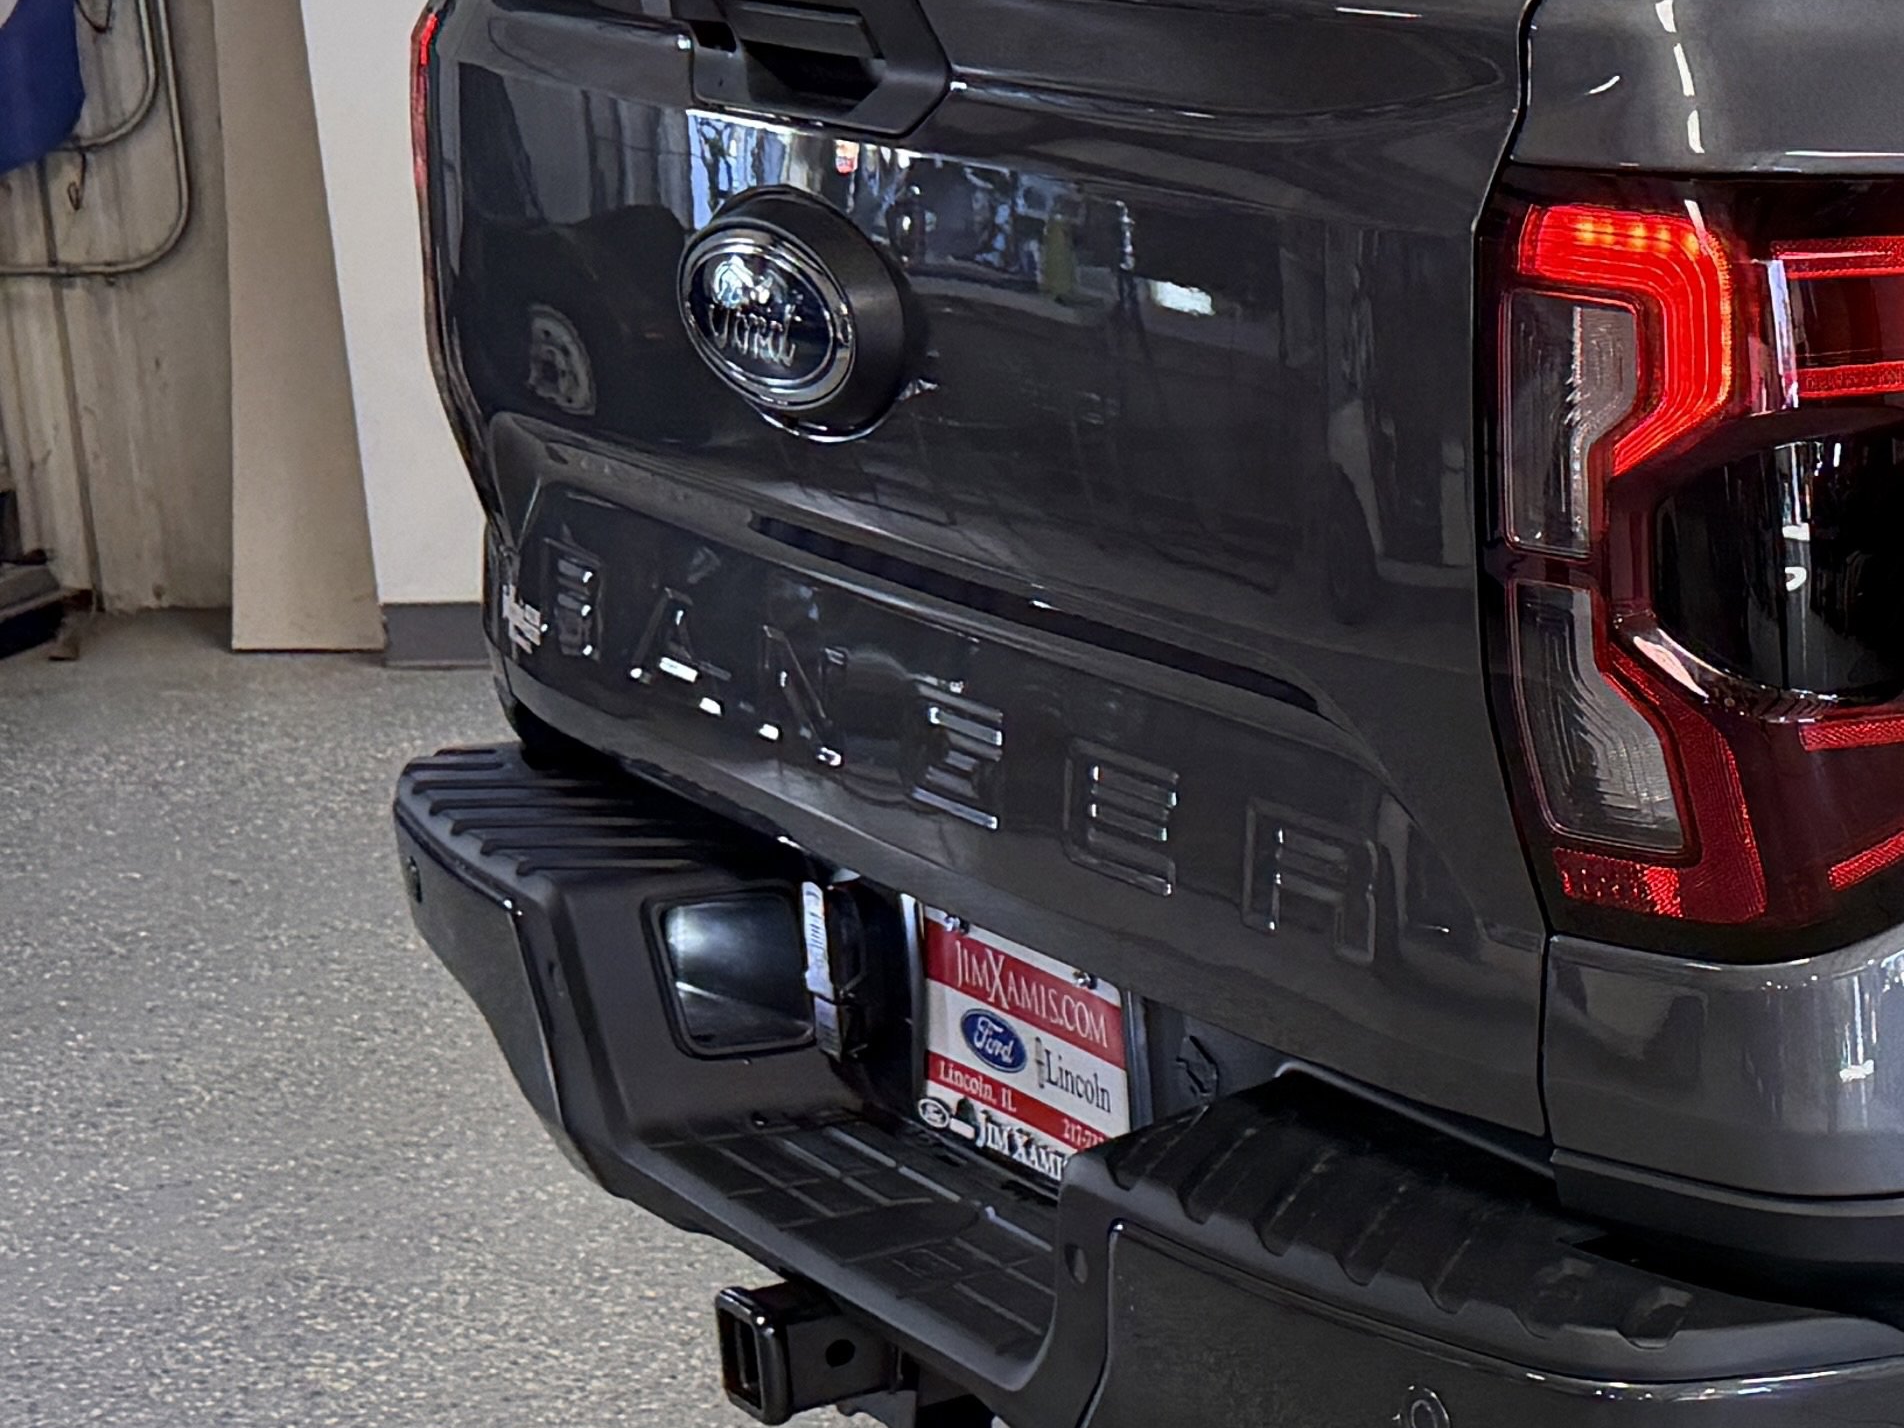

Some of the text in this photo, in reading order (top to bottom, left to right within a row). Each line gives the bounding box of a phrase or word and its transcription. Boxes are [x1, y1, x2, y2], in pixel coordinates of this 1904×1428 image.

[973, 1015, 1016, 1065] Ford
[1044, 1047, 1112, 1114] Lincoln
[1012, 1128, 1068, 1182] XAMI
